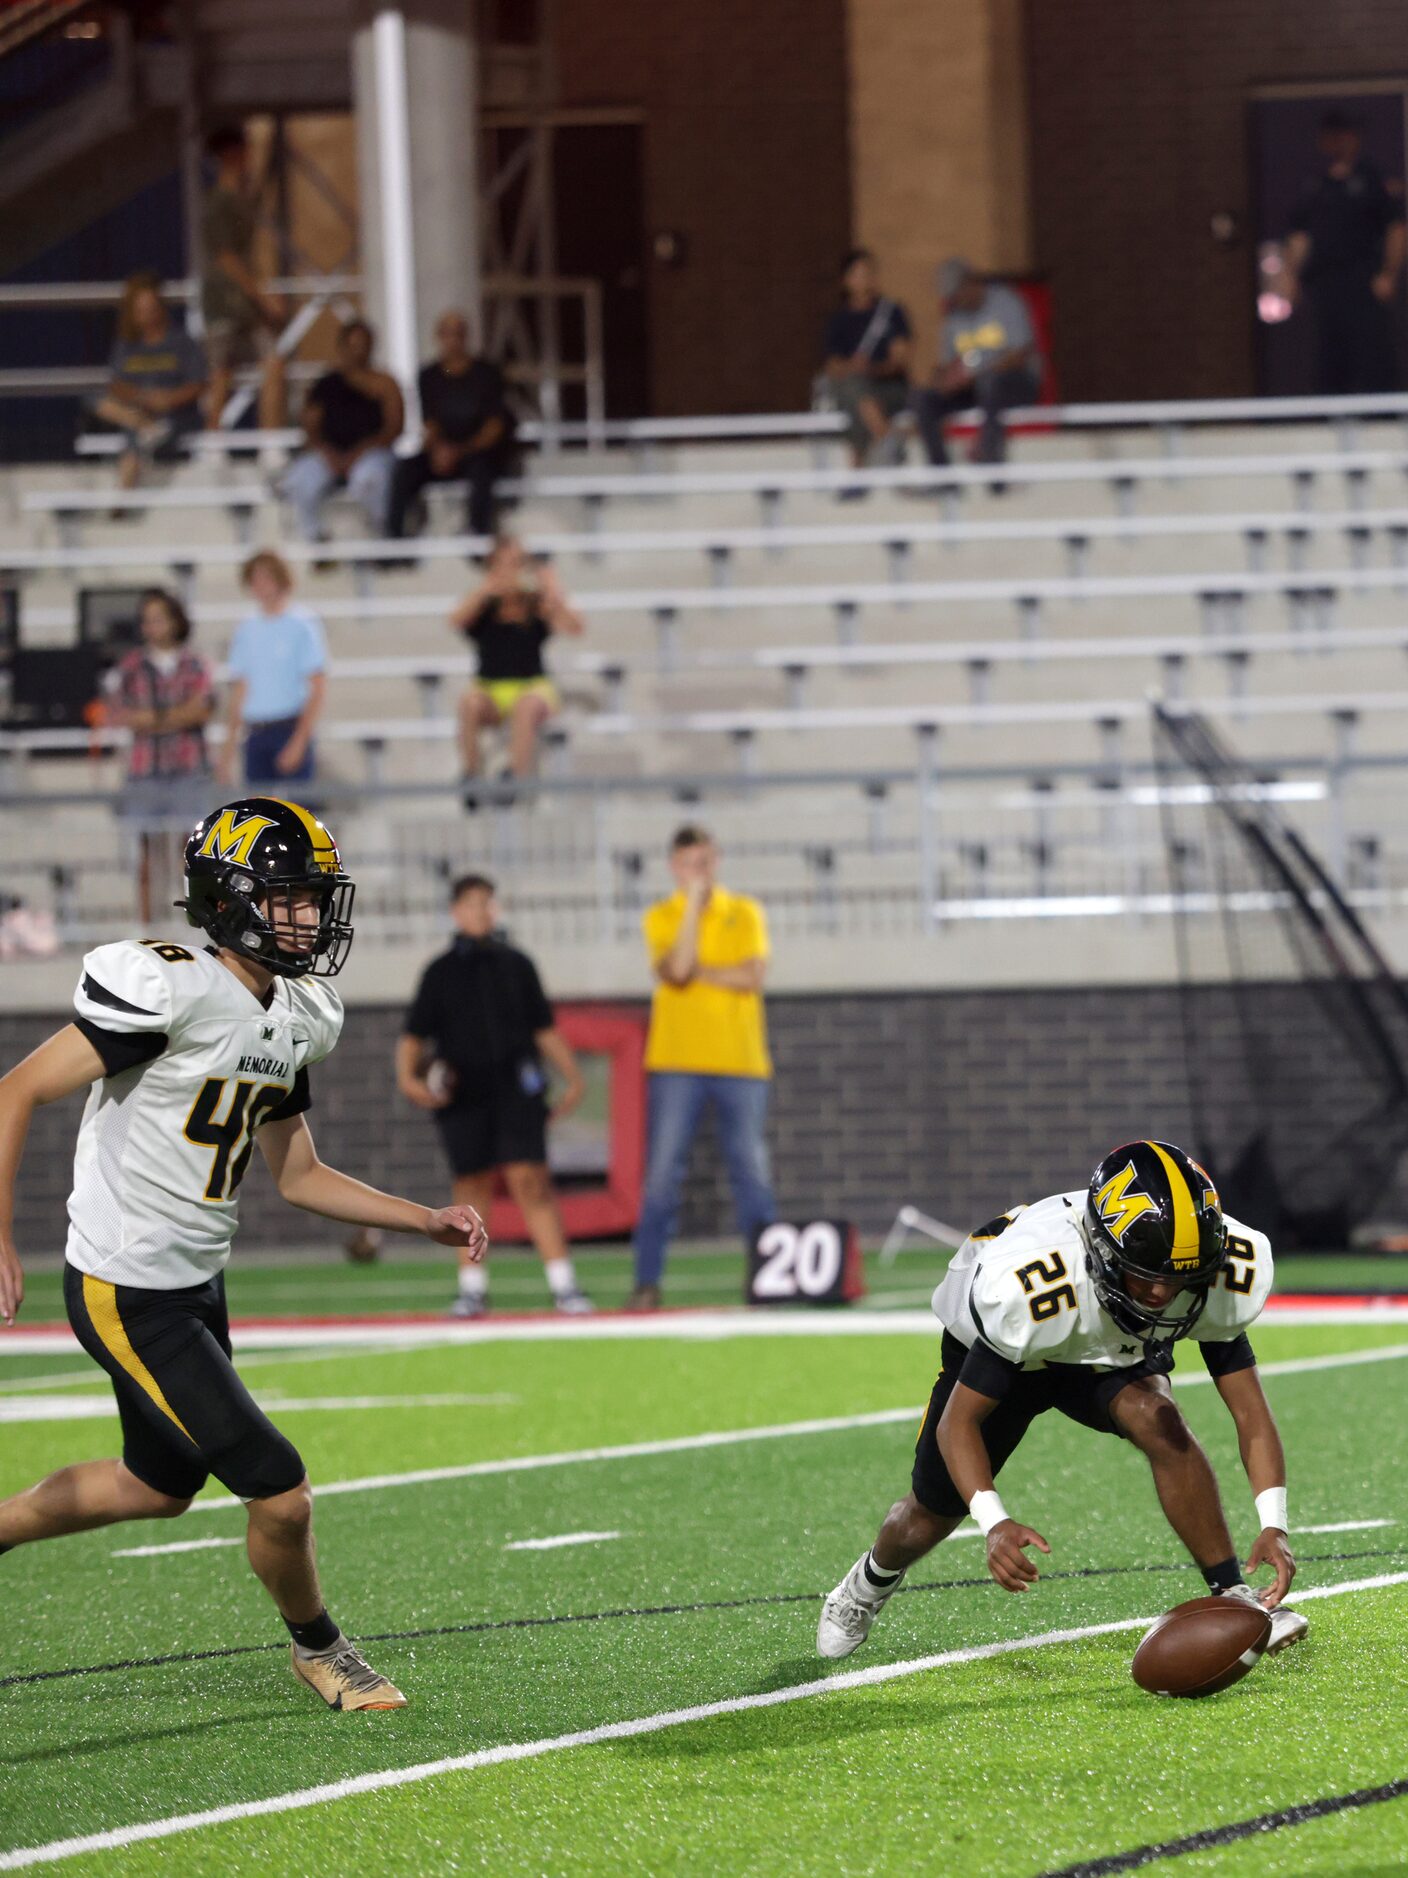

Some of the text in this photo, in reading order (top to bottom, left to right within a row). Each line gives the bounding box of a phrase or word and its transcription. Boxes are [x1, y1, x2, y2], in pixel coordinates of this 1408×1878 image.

[195, 808, 281, 871] M
[235, 1055, 290, 1078] MEMORIAL
[1094, 1158, 1162, 1249] M
[752, 1221, 842, 1297] 20
[1014, 1251, 1079, 1326] 26
